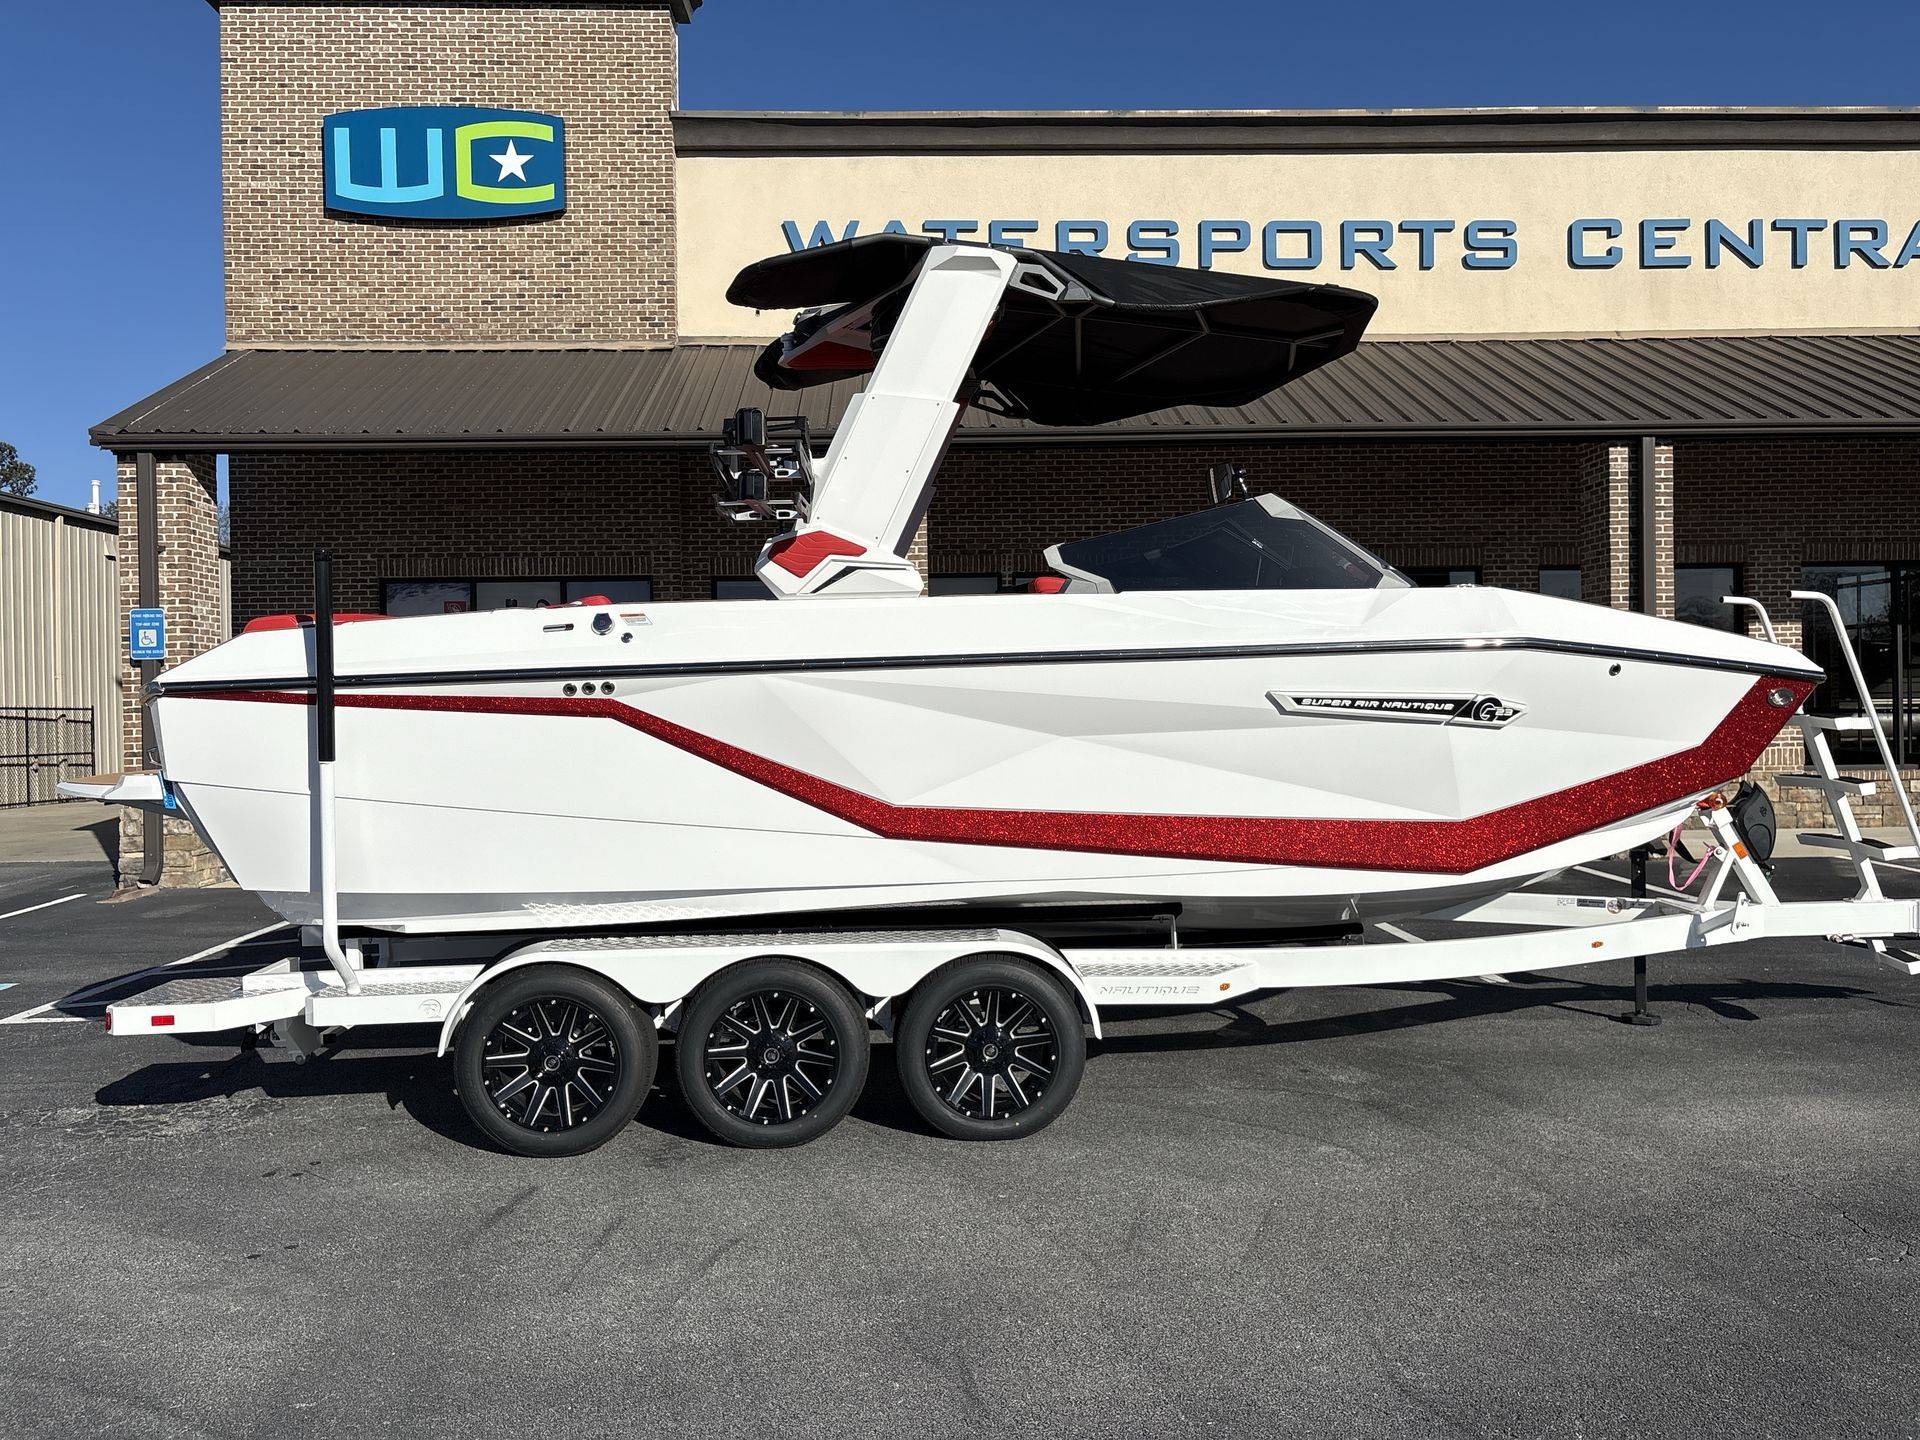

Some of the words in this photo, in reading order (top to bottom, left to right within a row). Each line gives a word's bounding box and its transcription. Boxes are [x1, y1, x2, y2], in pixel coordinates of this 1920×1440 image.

[781, 220, 1518, 270] WTERSPORTS
[1301, 699, 1352, 707] SUPER
[1354, 700, 1380, 708] AIR
[1381, 701, 1455, 710] NAUTIQUE
[1100, 986, 1201, 996] NAUTIQUE
